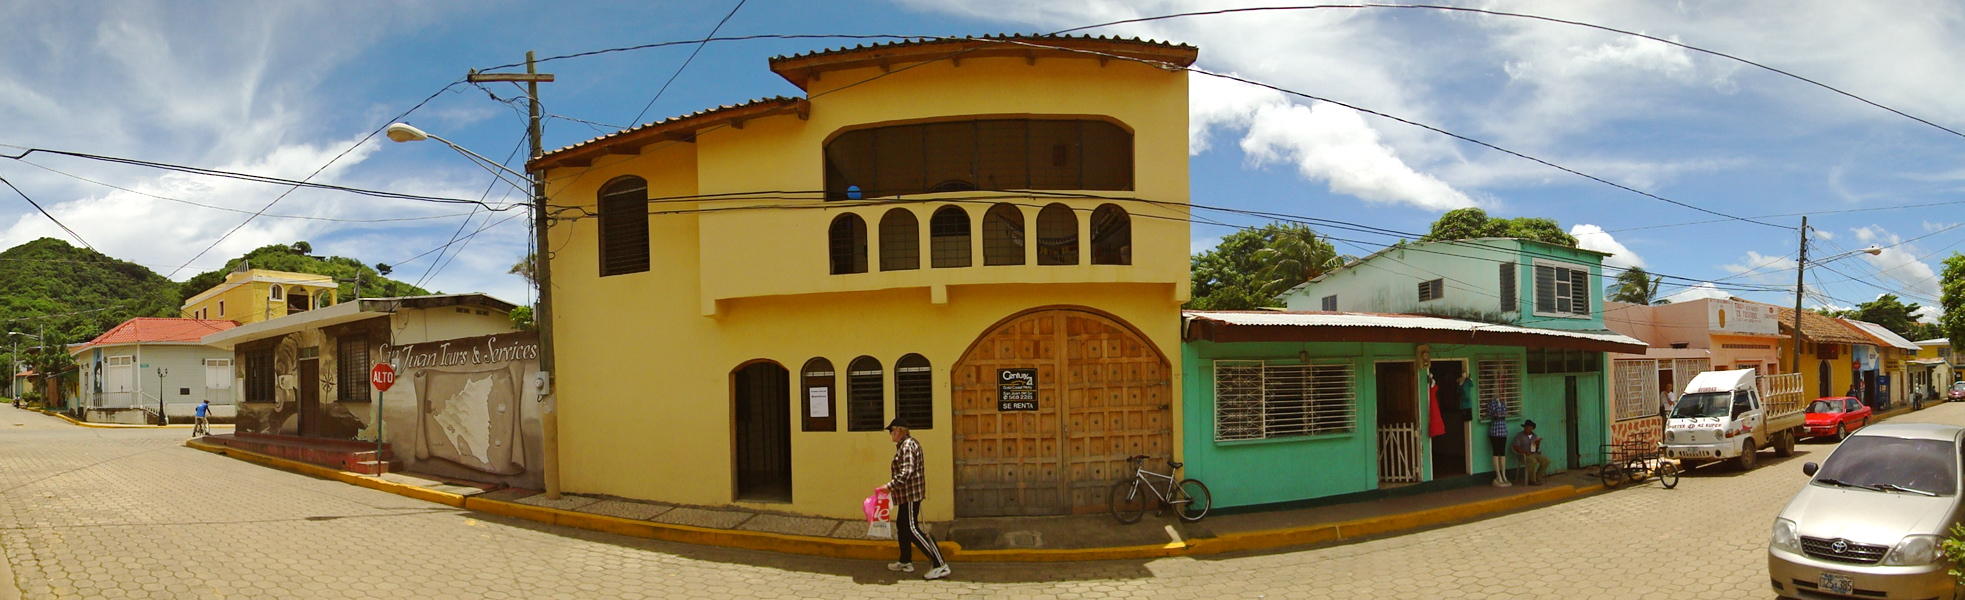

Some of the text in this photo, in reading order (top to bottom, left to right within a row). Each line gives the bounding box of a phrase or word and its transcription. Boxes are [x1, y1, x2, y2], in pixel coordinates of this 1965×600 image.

[400, 344, 437, 372] Juan
[440, 342, 467, 367] Tours
[471, 346, 481, 365] &
[484, 336, 538, 364] Services
[373, 370, 394, 384] ALTO
[1002, 370, 1029, 380] Century
